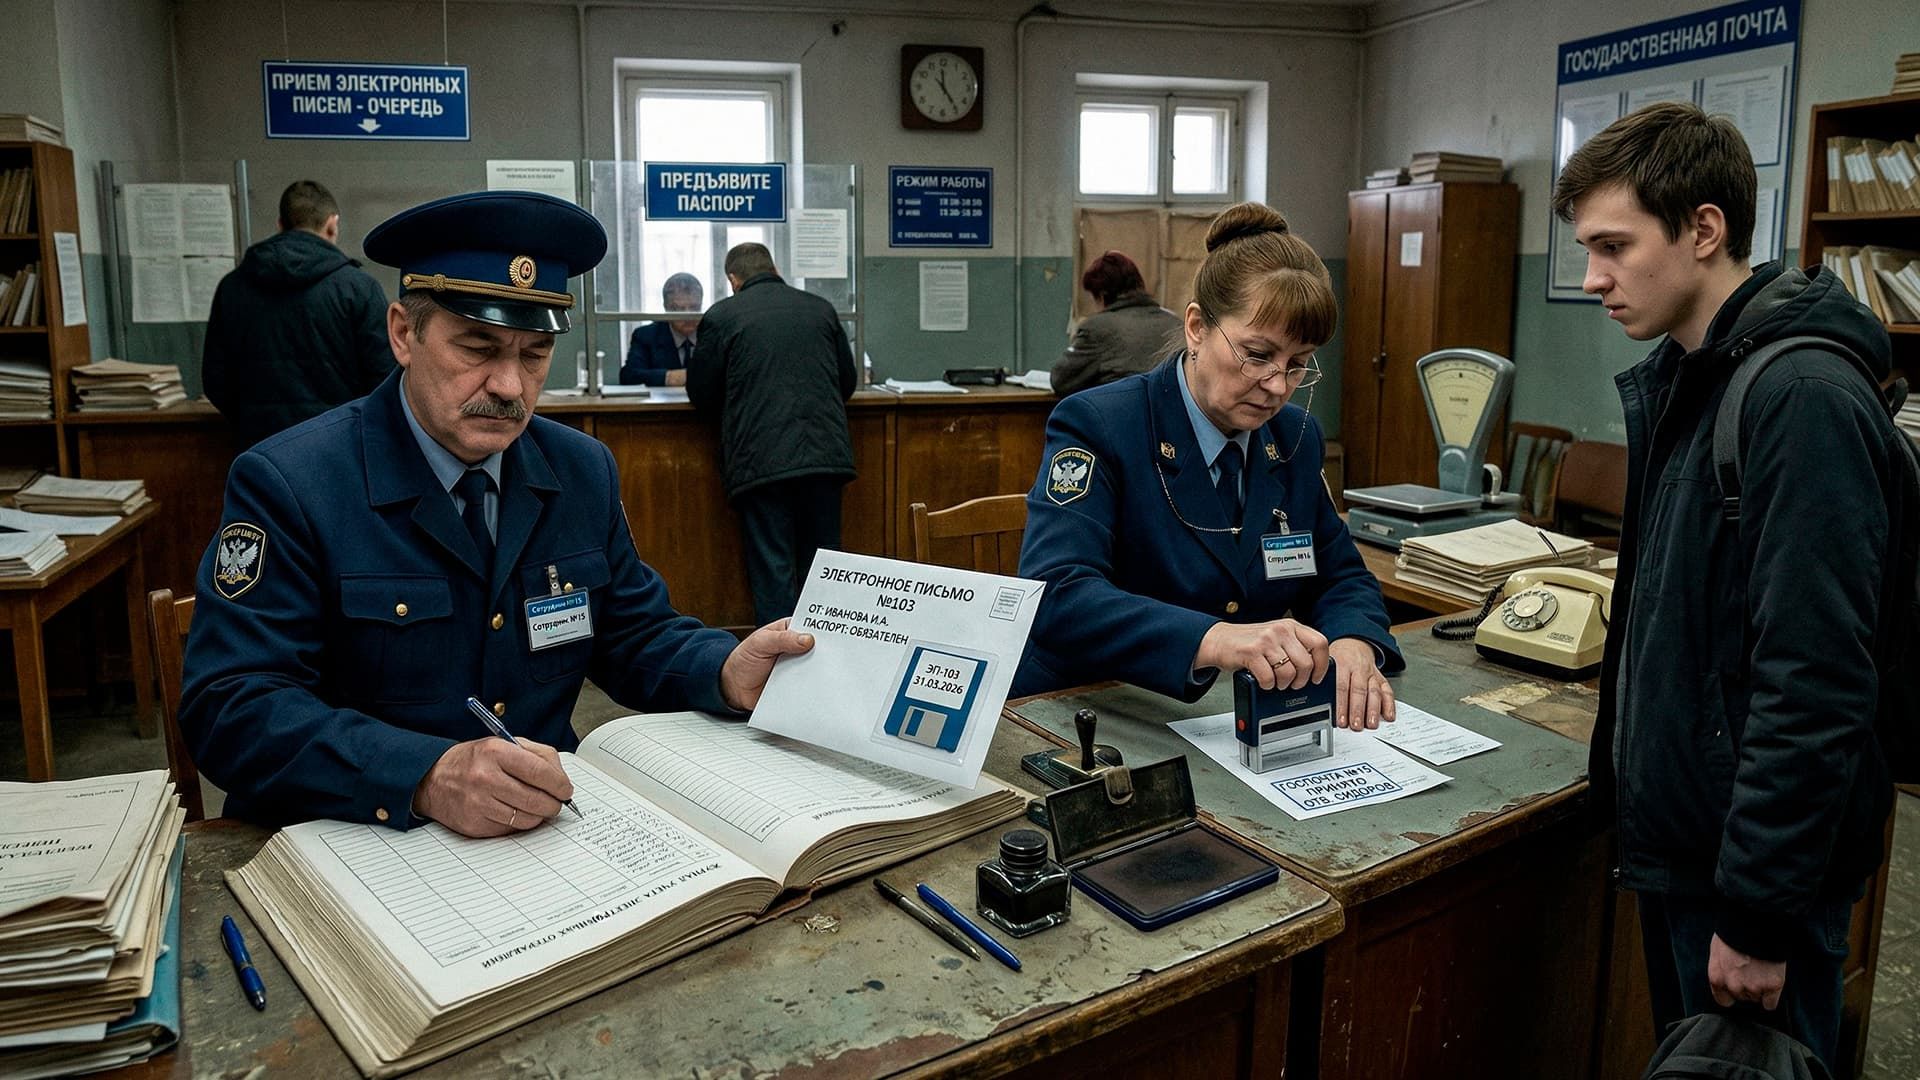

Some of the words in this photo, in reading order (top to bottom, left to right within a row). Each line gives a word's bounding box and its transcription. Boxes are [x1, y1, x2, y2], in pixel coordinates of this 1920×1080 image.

[1564, 21, 1718, 74] ГОСУДАРСТВЕННАЯ
[1723, 5, 1788, 44] ПОЧТА
[272, 73, 331, 91] ПРИЕМ
[336, 75, 461, 94] ЭЛЕКТРОННЫХ
[292, 96, 351, 113] ПИСЕМ
[368, 97, 444, 118] ОЧЕРЕДЬ
[660, 172, 771, 192] ПРЕДЪЯВИТЕ
[896, 175, 938, 188] РЕЖИМ
[941, 176, 986, 189] РАБОТЫ
[678, 194, 755, 212] ПАСПОРТ
[820, 567, 912, 592] ЭЛЕКТРОННОЕ
[914, 581, 975, 602] ПИСЬМО
[876, 594, 916, 613] №103
[808, 603, 823, 616] ОТ:
[824, 606, 869, 624] ИВАНОВА
[870, 614, 889, 627] И.А.
[803, 617, 849, 635] ПАСПОРТ:
[849, 626, 909, 645] ОБЯЗАТЕЛЕН
[925, 663, 961, 681] ЭП-103
[913, 675, 964, 695] 31.03.2026
[1279, 772, 1343, 792] ГОСПОЧТА
[1344, 765, 1373, 780] №15
[1306, 777, 1367, 797] ПРИНЯТО
[1303, 795, 1334, 809] ОТВ.
[1336, 781, 1395, 801] СИДОРОВ
